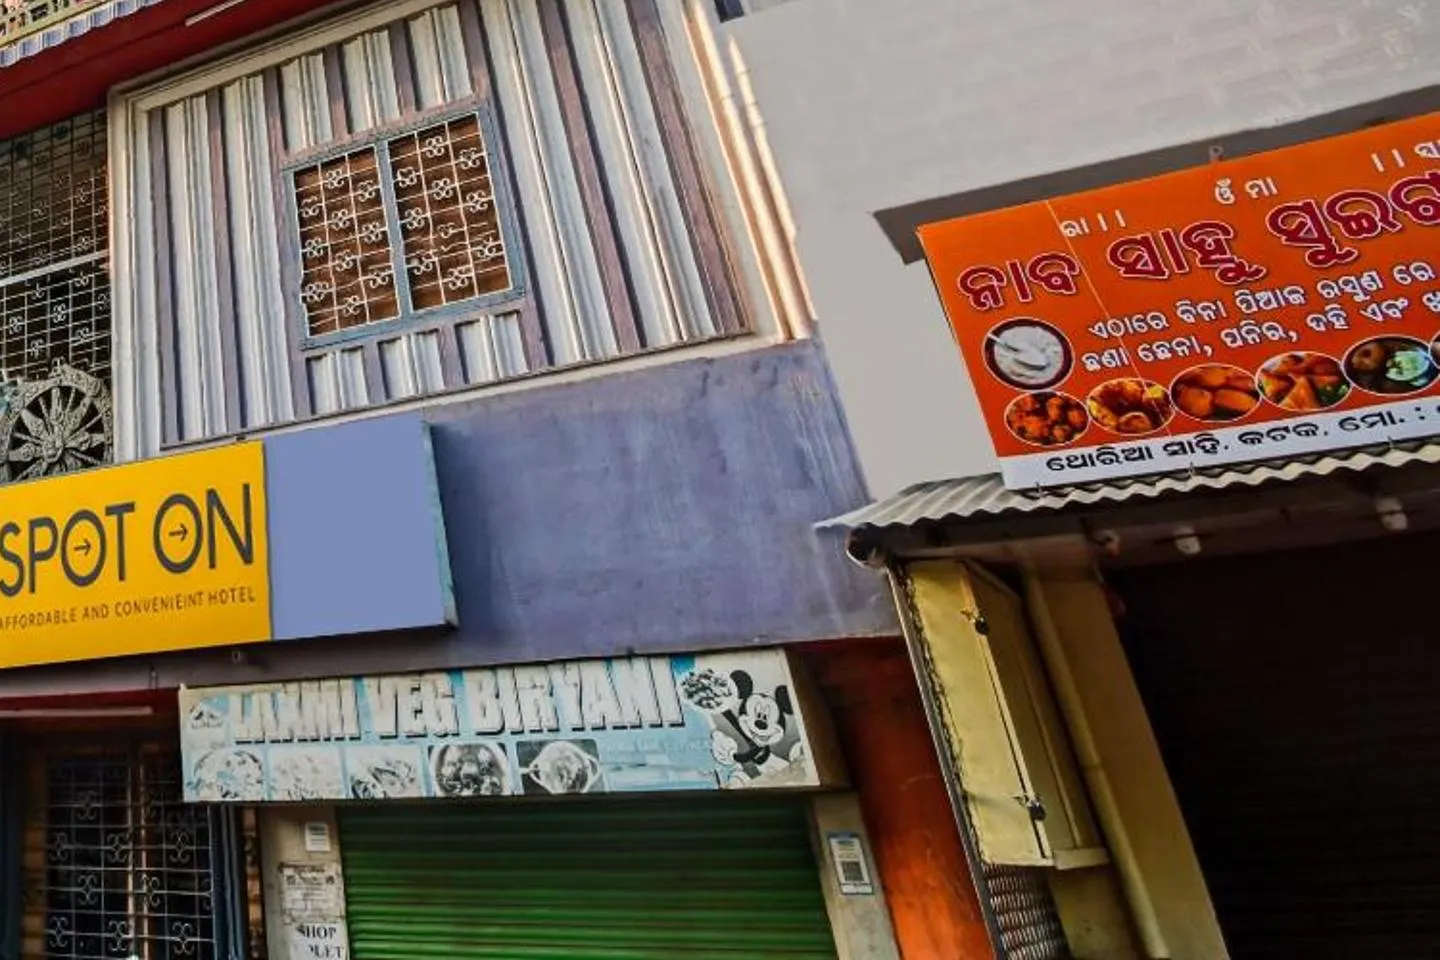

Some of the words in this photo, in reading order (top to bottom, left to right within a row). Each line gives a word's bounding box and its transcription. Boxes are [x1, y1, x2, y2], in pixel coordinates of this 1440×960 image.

[1106, 220, 1267, 284] ସାହୁ
[153, 483, 254, 574] ON
[82, 603, 110, 620] AND
[208, 585, 257, 606] HOTEL
[365, 672, 460, 738] VEG
[464, 656, 686, 736] BIRYANI
